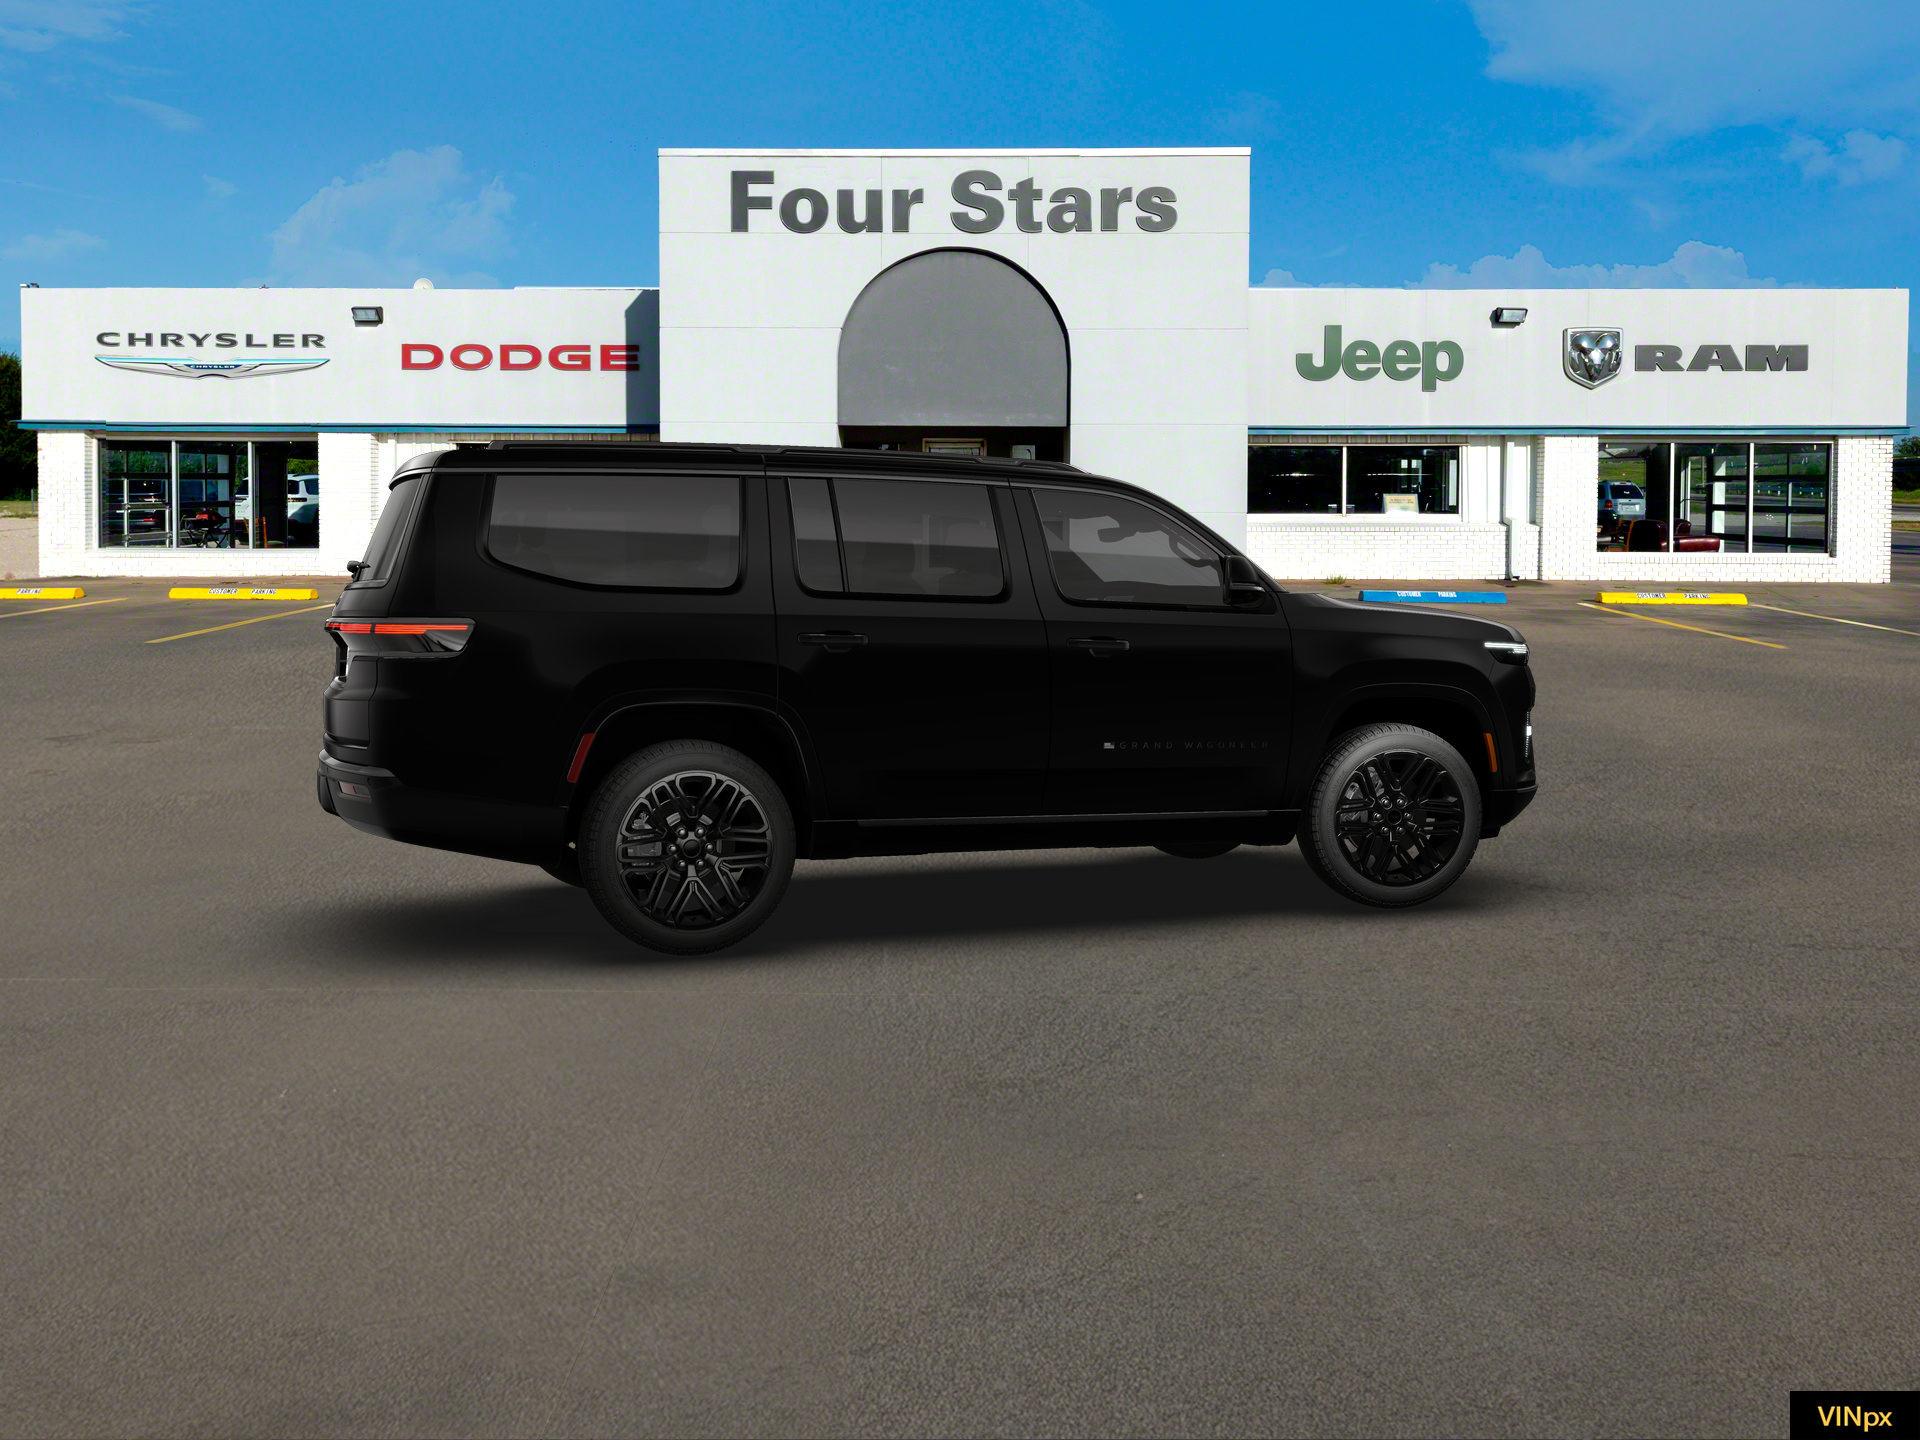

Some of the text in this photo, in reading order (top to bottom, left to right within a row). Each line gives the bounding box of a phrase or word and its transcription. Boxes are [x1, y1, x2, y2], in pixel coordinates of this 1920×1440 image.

[730, 169, 1179, 234] Four Stars
[96, 332, 327, 348] CHRYSLER
[401, 343, 640, 371] DODGE
[1296, 325, 1464, 392] Jeep
[1634, 344, 1809, 372] RAM
[1119, 741, 1173, 750] GRAND
